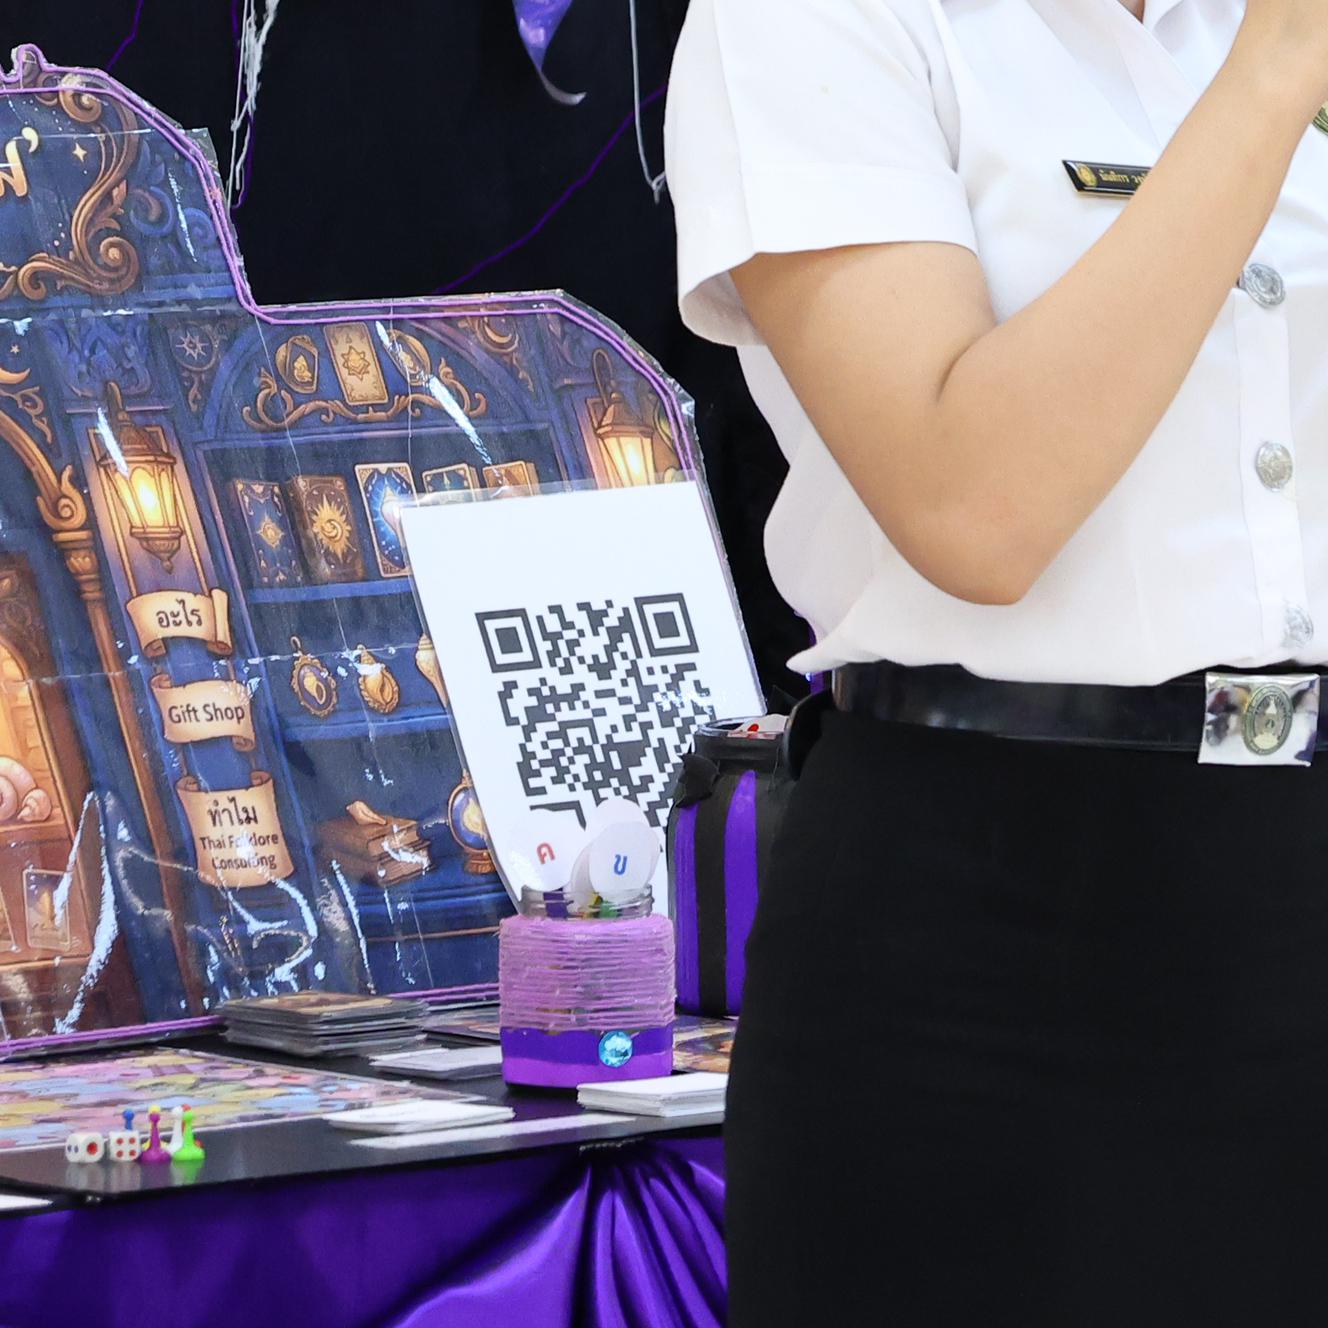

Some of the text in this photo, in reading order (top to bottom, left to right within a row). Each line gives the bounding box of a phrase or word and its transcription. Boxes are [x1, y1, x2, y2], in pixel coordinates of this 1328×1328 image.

[156, 598, 203, 629] อะไร
[168, 701, 246, 724] Gift Shop
[207, 795, 259, 827] ทำไม
[199, 832, 279, 850] Thai Folore
